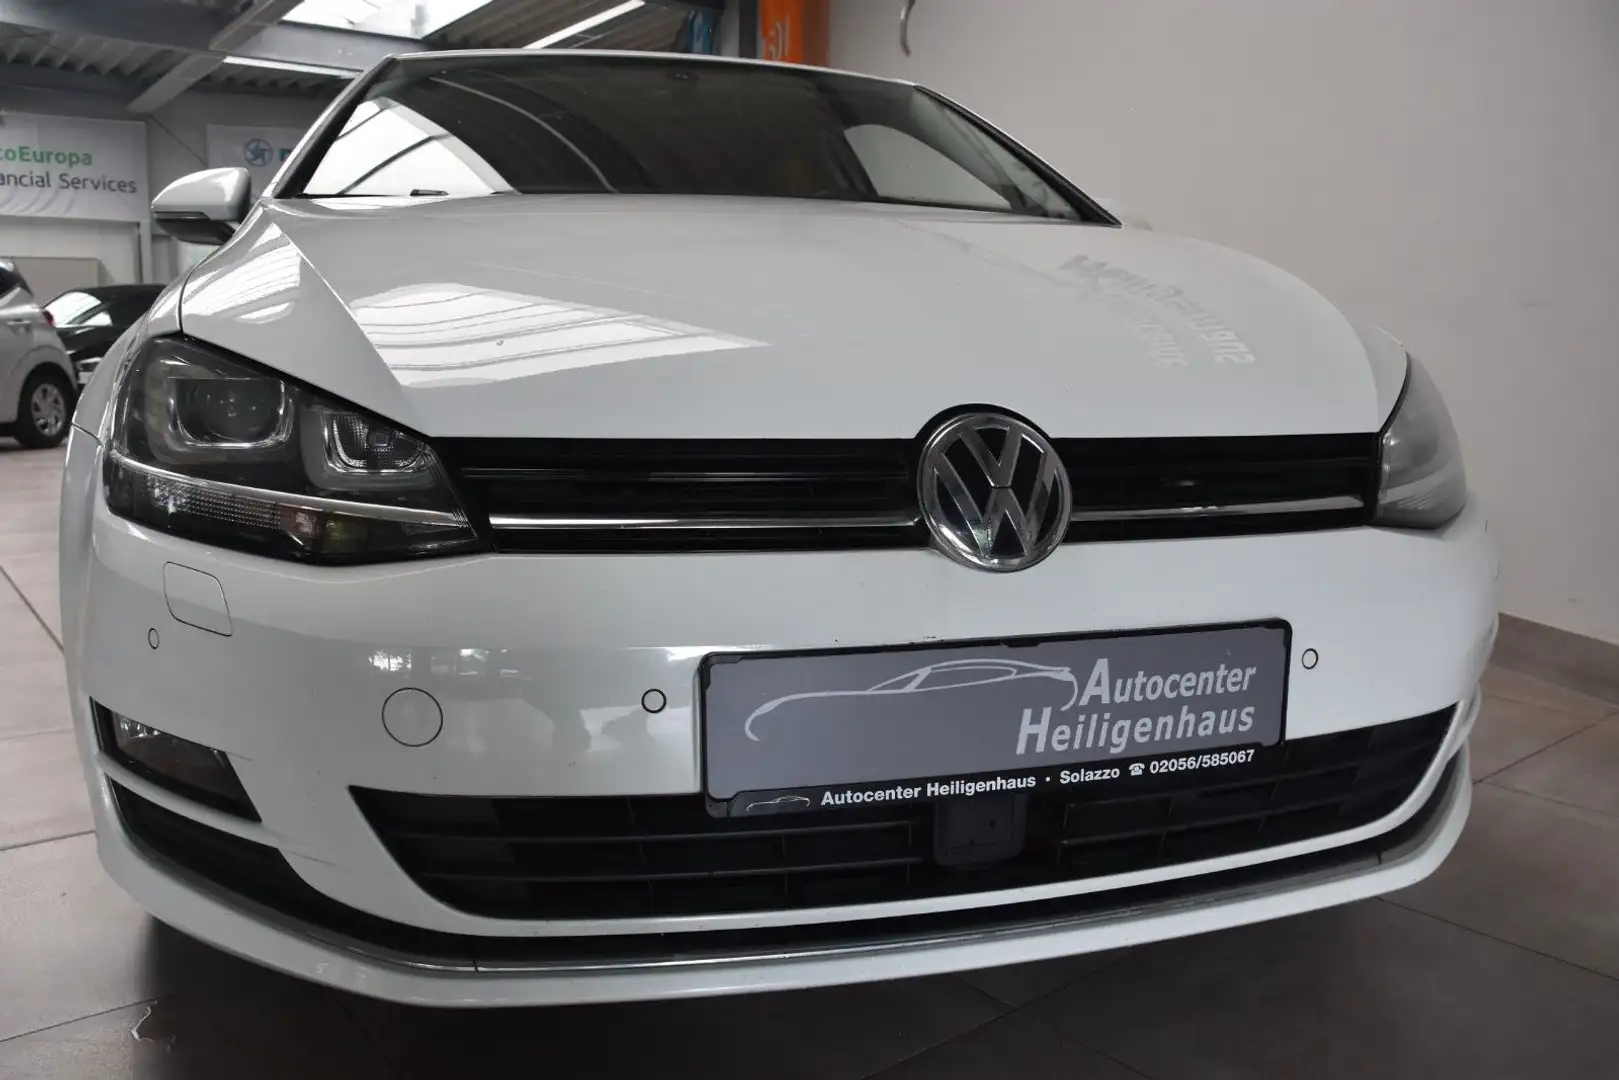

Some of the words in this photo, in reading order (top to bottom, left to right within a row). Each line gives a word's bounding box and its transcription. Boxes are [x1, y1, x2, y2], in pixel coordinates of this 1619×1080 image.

[58, 172, 138, 194] Services
[1078, 657, 1257, 706] Autocenter
[1015, 705, 1255, 755] Heiligenhaus
[821, 785, 922, 806] Autocenter
[926, 774, 1037, 796] Heiligenhaus
[1059, 766, 1121, 785] Solazzo
[1150, 749, 1255, 774] 02056/585067
